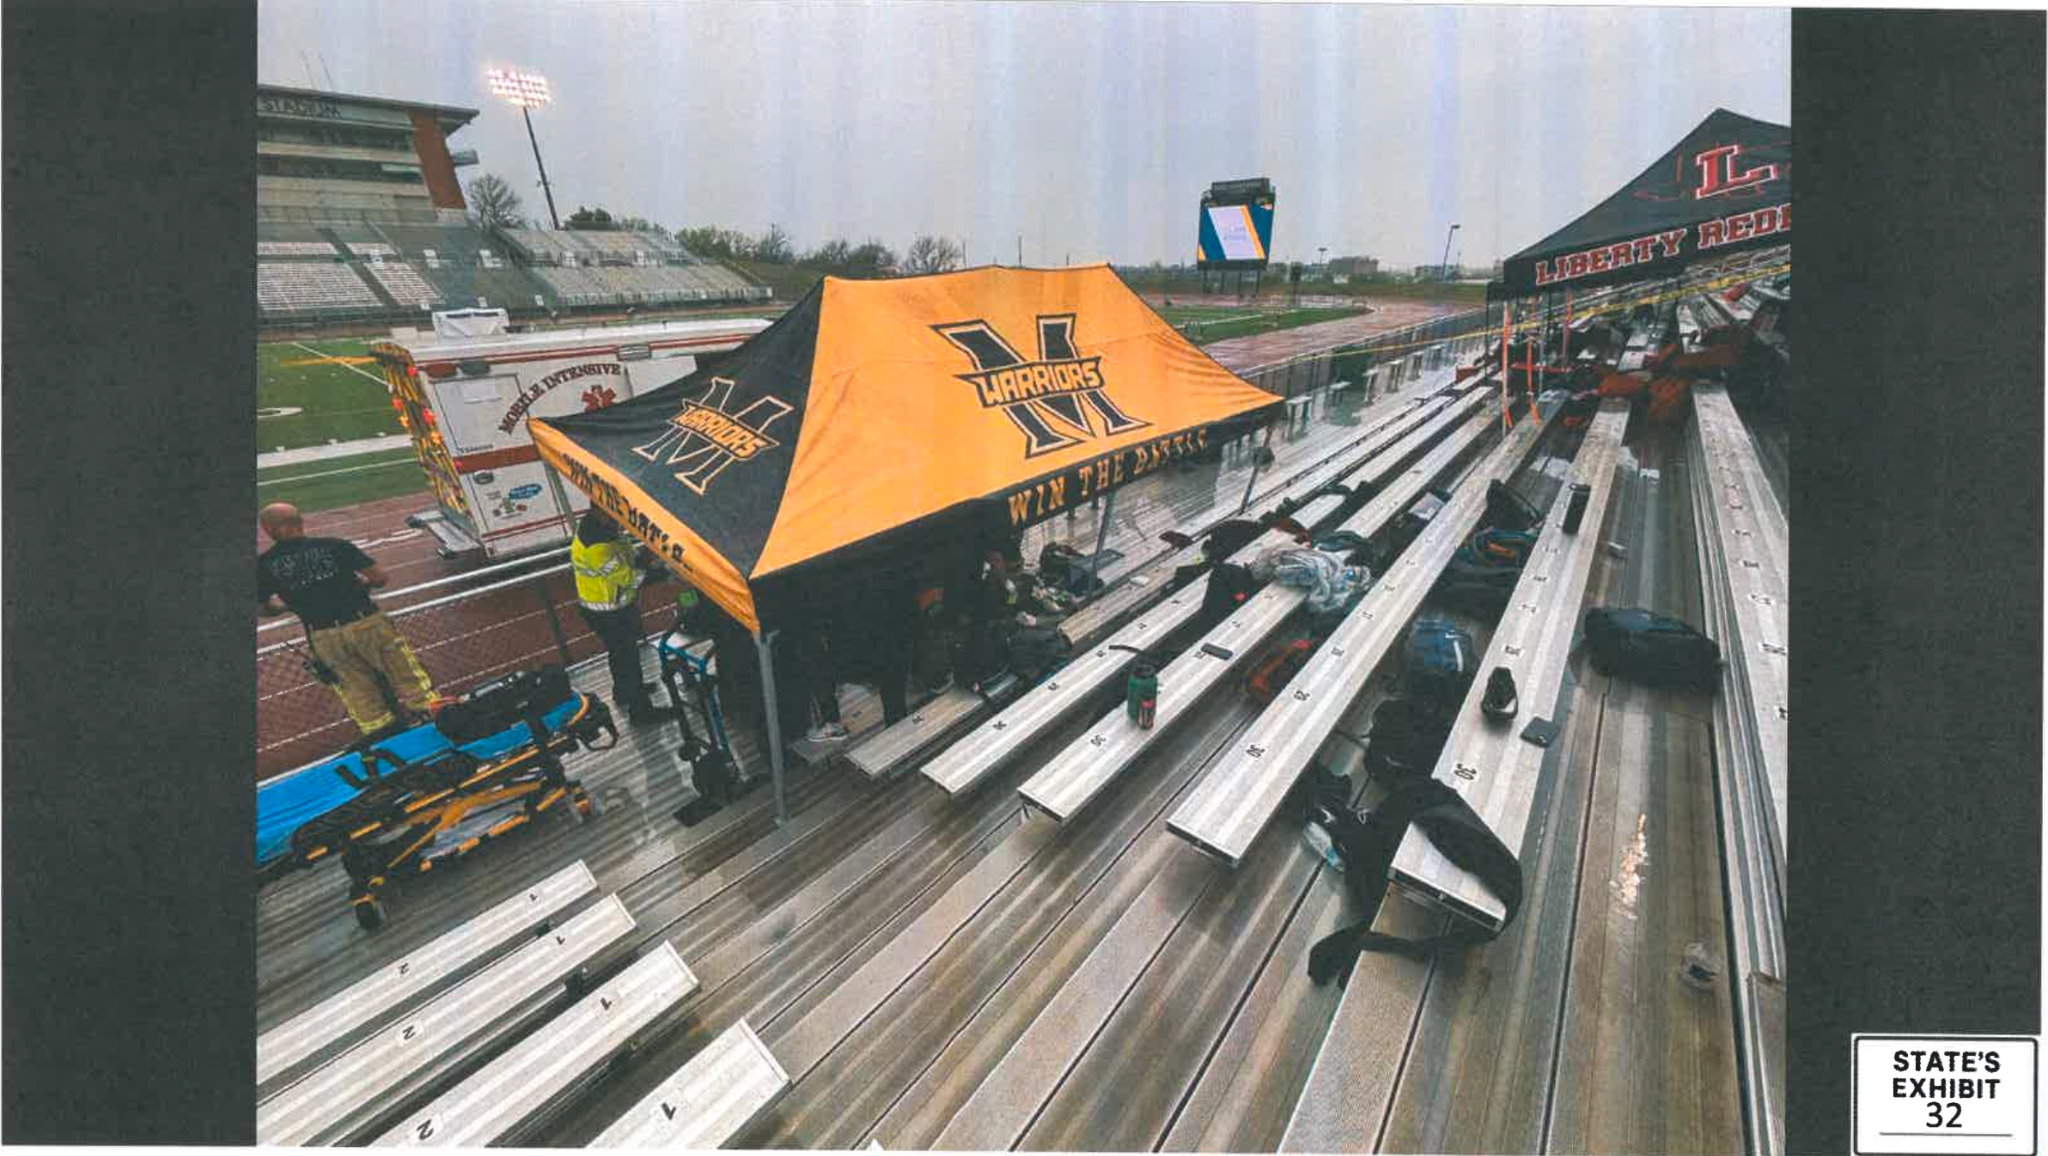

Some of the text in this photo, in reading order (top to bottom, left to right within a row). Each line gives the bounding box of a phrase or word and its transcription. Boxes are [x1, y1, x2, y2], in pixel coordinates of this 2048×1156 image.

[1695, 143, 1778, 200] L
[1536, 228, 1687, 285] LIBERTY
[499, 362, 621, 435] MOBILE INTENSIVE
[980, 359, 1101, 404] WARRIORS
[675, 404, 769, 459] WARRIORS
[1008, 429, 1209, 527] WIN THE BATTLE
[416, 1118, 435, 1141] 2
